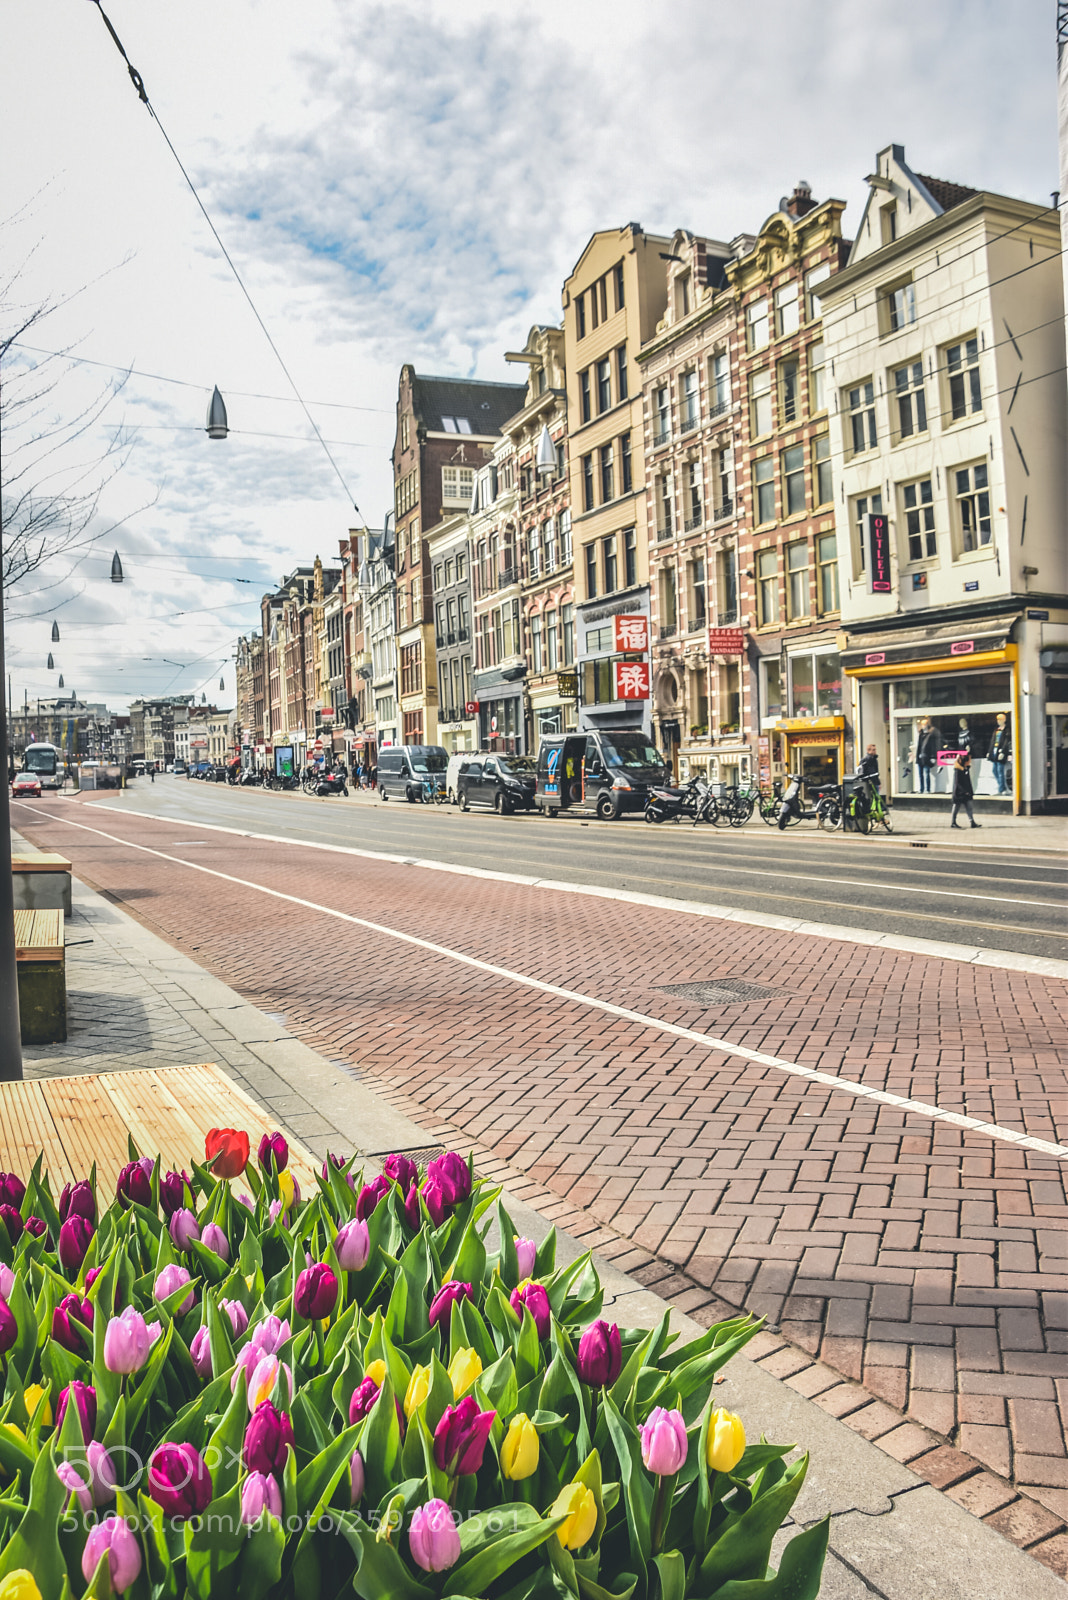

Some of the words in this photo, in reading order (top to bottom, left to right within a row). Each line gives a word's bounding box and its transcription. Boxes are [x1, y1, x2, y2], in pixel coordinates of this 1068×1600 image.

[874, 518, 885, 580] OUTLET
[617, 619, 647, 649] 福
[800, 733, 836, 744] SOUVENIRS
